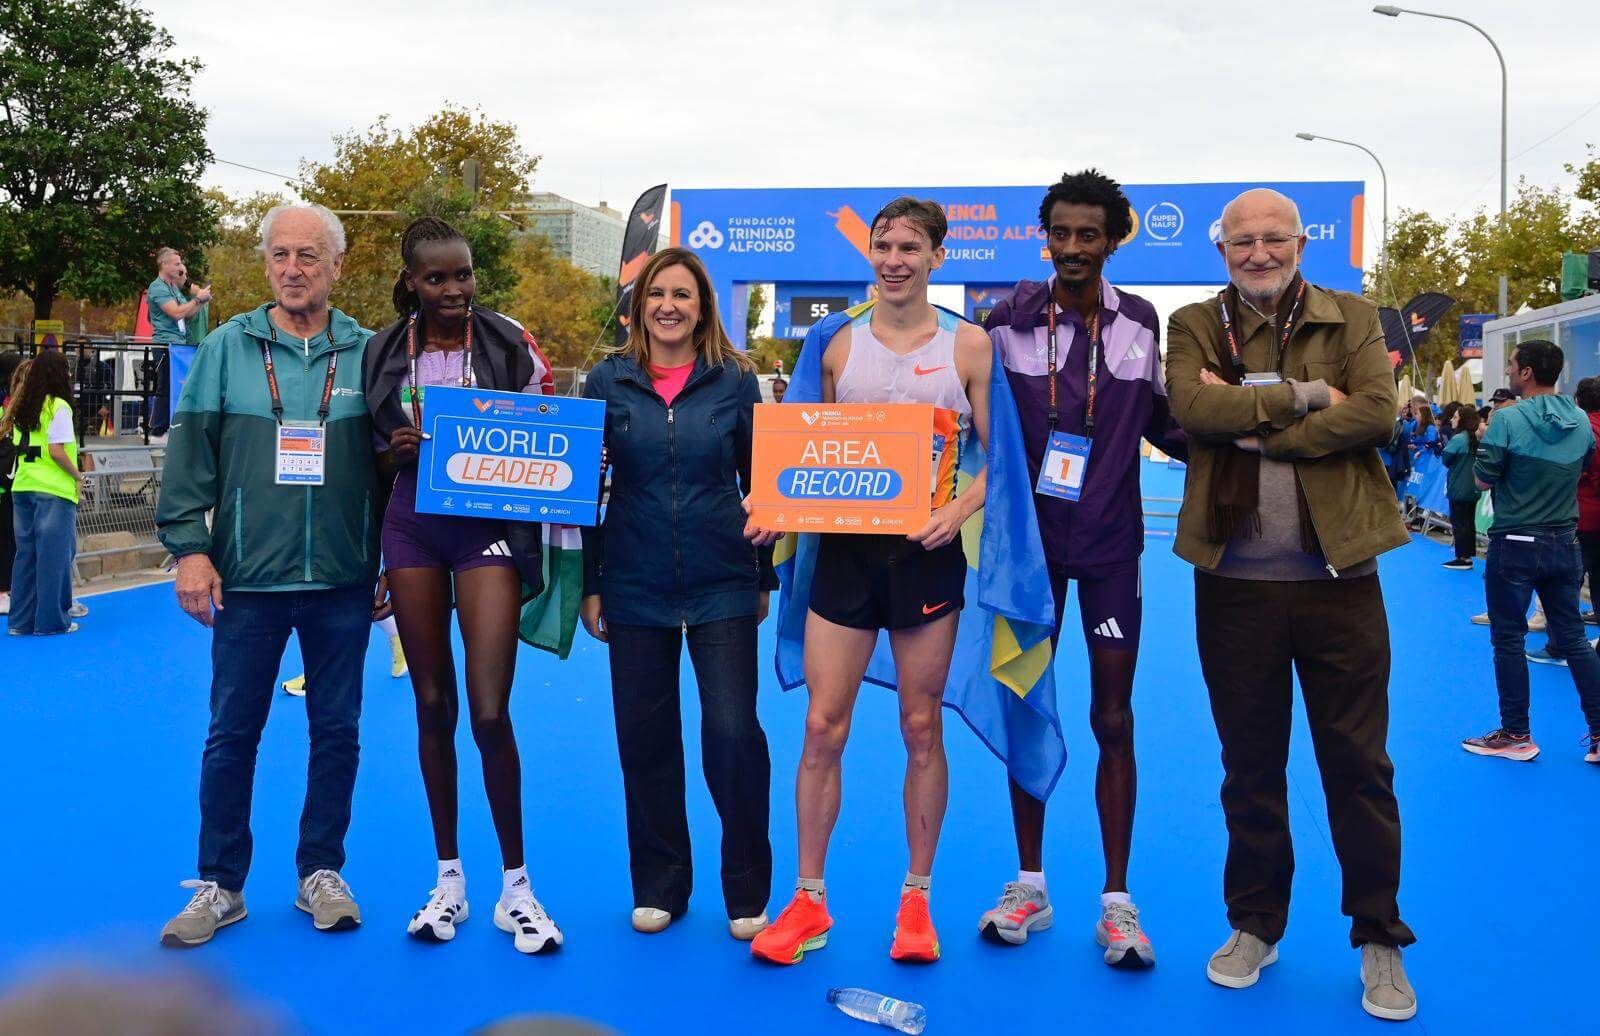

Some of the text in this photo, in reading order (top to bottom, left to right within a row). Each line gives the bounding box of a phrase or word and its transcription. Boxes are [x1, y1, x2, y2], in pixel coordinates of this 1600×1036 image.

[941, 204, 997, 221] LENCIA
[728, 217, 796, 226] FUNDACIÓN
[728, 228, 796, 240] TRINIDAD
[944, 226, 1048, 240] NIDAD ALFO
[728, 240, 796, 253] ALFONSO
[944, 248, 995, 260] ZURICH
[810, 303, 829, 317] 55
[791, 327, 810, 337] FIN
[457, 425, 569, 457] WORLD
[800, 440, 881, 465] AREA
[461, 456, 558, 487] LEADER
[1060, 458, 1071, 481] 1
[790, 471, 891, 496] RECORD
